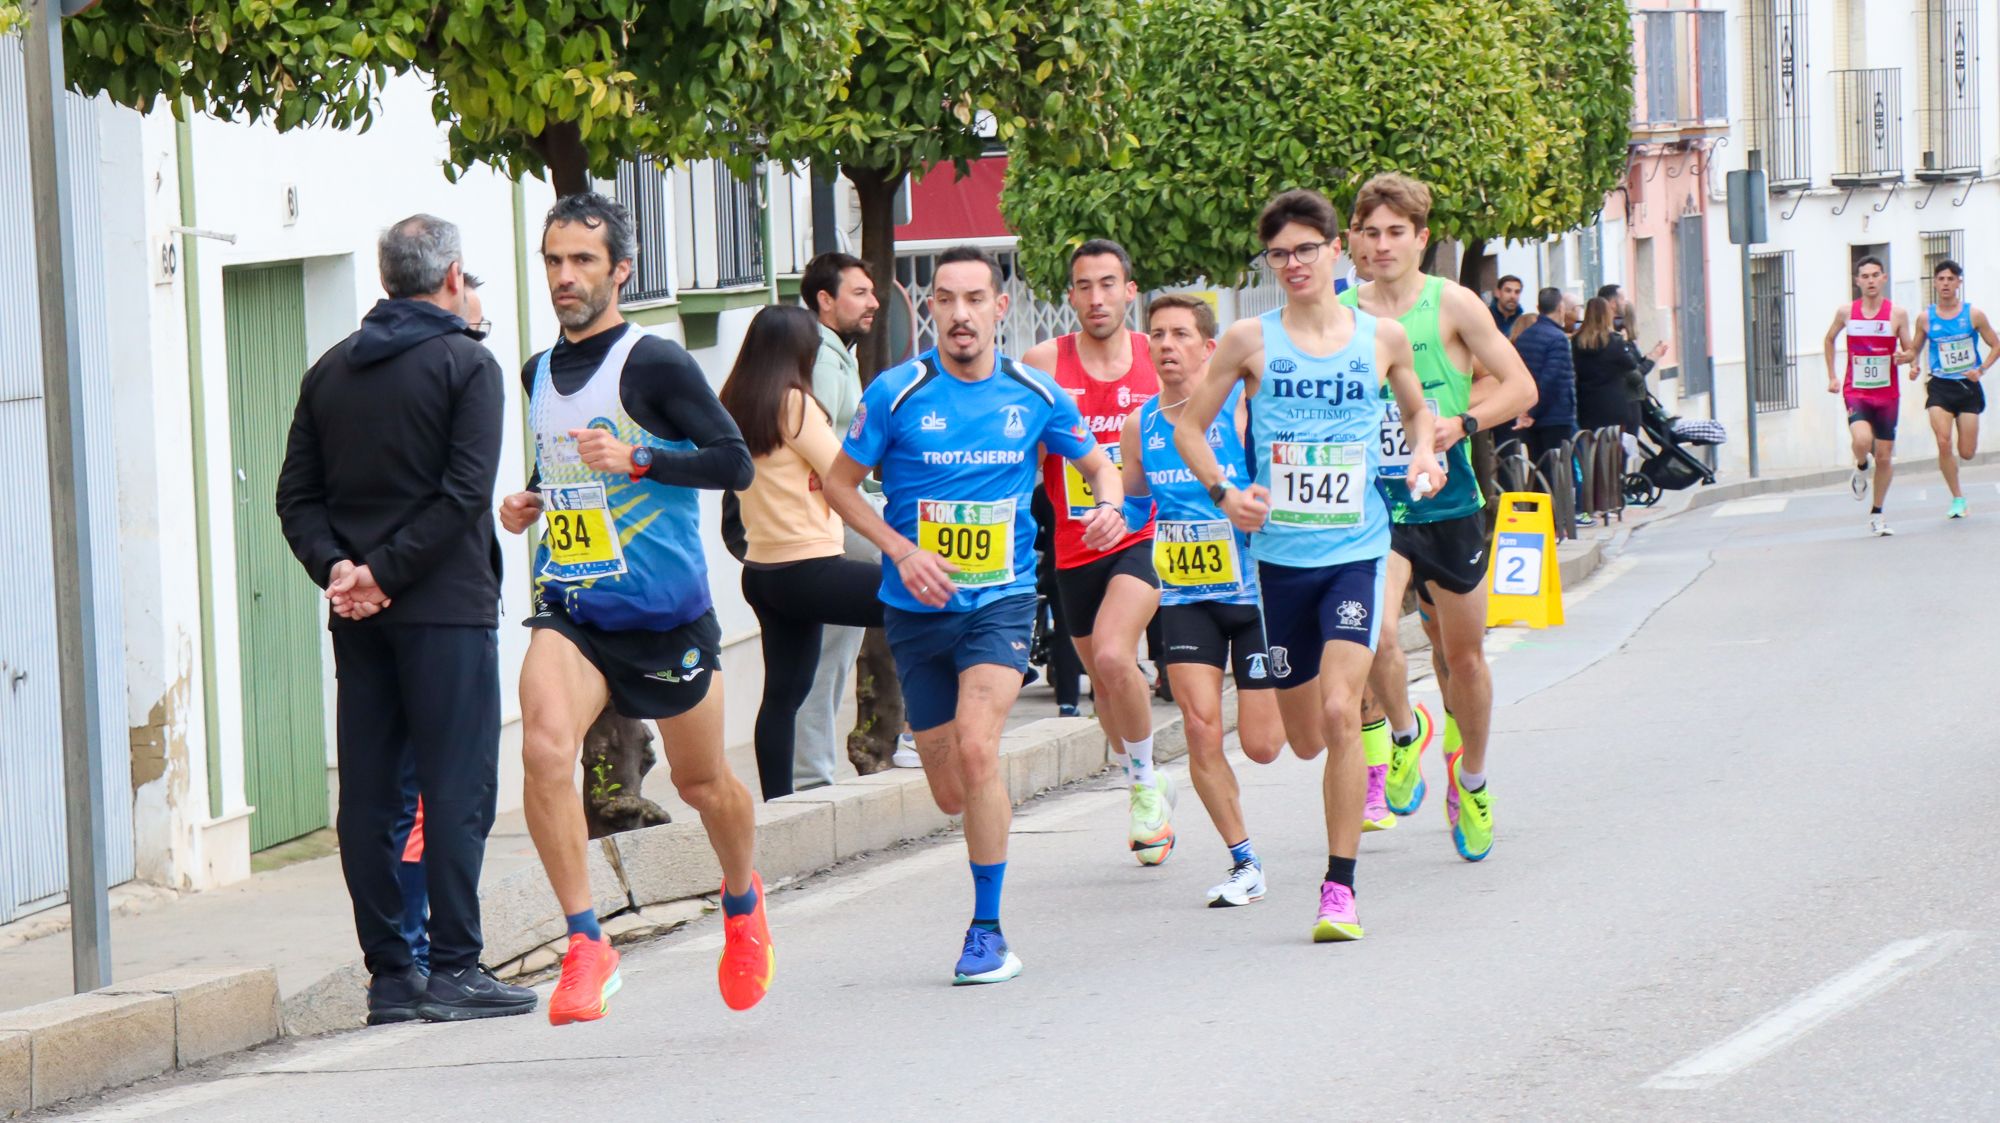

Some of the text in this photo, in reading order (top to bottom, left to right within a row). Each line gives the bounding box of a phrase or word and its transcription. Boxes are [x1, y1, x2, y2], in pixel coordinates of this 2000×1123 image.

[1944, 350, 1970, 366] 1544
[1864, 366, 1878, 378] 90
[1272, 372, 1364, 406] nerja
[921, 411, 947, 430] als
[1287, 408, 1352, 420] ATLETISMO
[922, 451, 1025, 464] TROTASIERRA
[1278, 444, 1307, 466] 10K
[1283, 472, 1350, 504] 1542
[926, 503, 957, 523] 10K
[547, 514, 591, 551] 34
[1499, 537, 1517, 546] km
[938, 527, 991, 560] 909
[1166, 544, 1222, 574] 1443
[1505, 556, 1525, 582] 2
